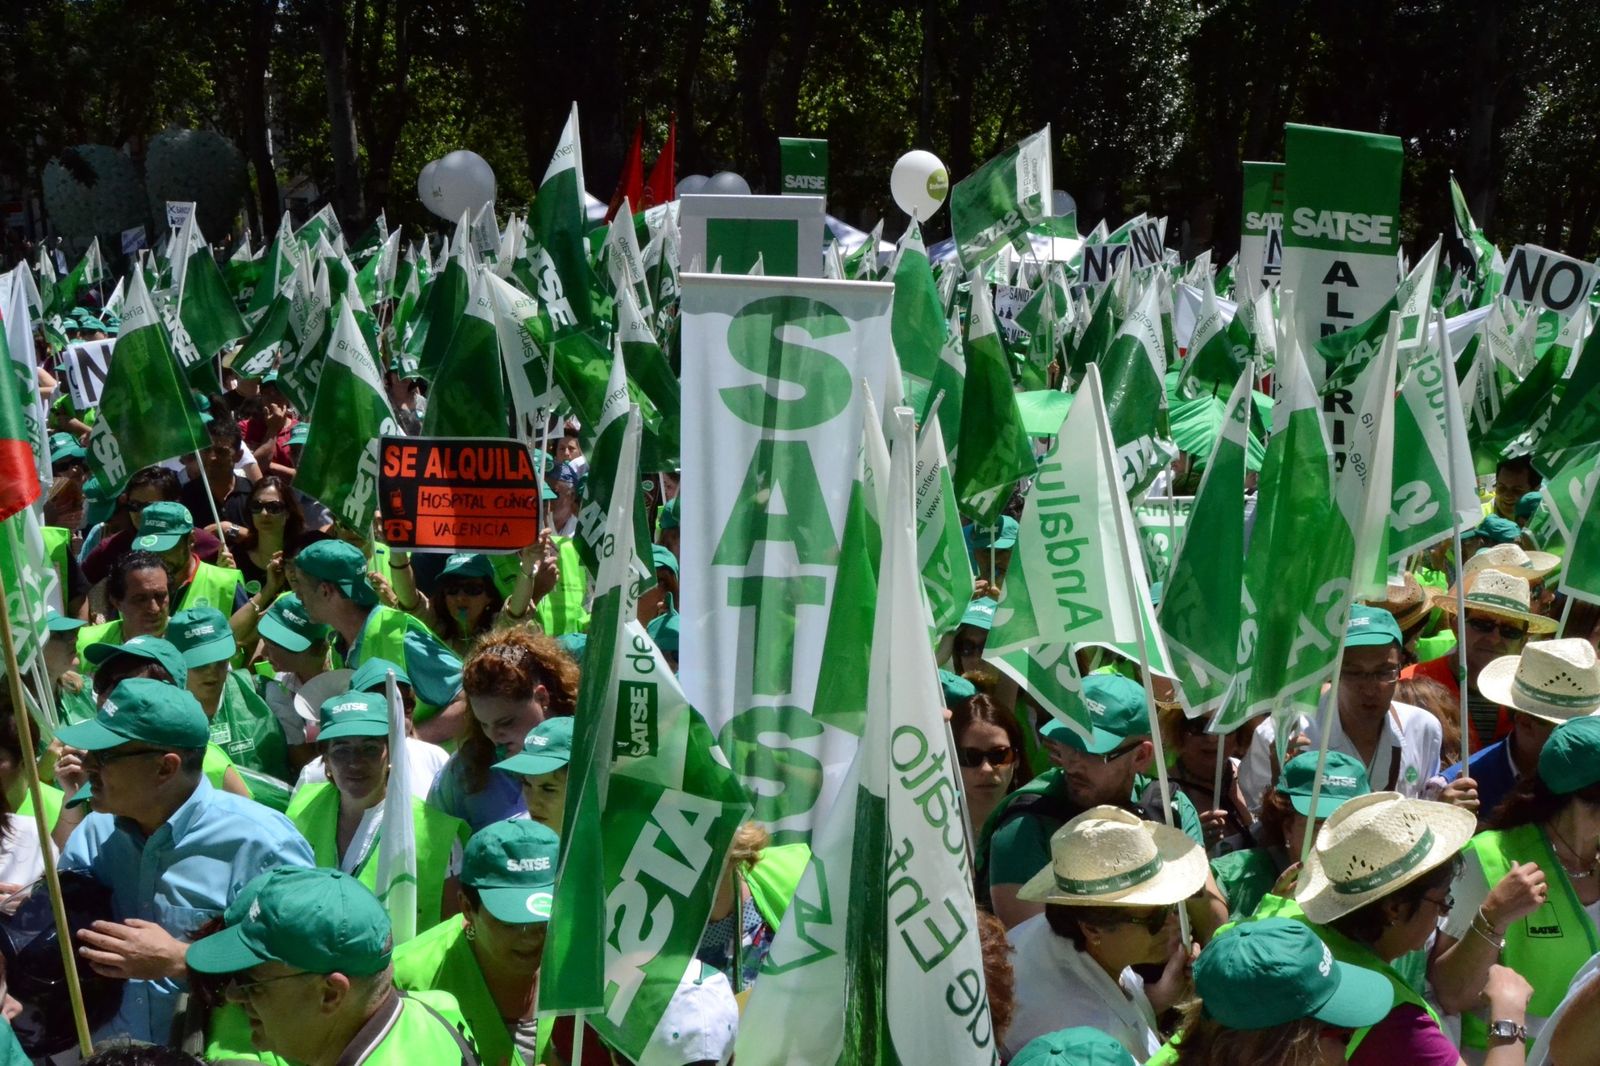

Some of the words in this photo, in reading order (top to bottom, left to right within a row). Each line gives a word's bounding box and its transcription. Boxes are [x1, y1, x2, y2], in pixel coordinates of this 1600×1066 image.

[785, 175, 825, 189] SATSE
[1245, 211, 1284, 230] SAT
[1292, 207, 1393, 245] SATSE
[1131, 222, 1163, 268] NO
[1503, 250, 1583, 311] NO
[74, 343, 113, 402] N
[92, 413, 128, 487] TSE
[384, 445, 418, 478] SE
[424, 447, 535, 482] ALQUILA
[421, 491, 487, 510] HOSPITAL
[433, 521, 511, 537] VALENCIA
[711, 295, 853, 846] SATS
[184, 625, 215, 639] SATSE
[625, 634, 656, 675] de
[332, 702, 369, 715] SATSE
[630, 686, 650, 758] SATSE
[506, 857, 551, 872] SATSE
[1529, 925, 1561, 934] SATSE
